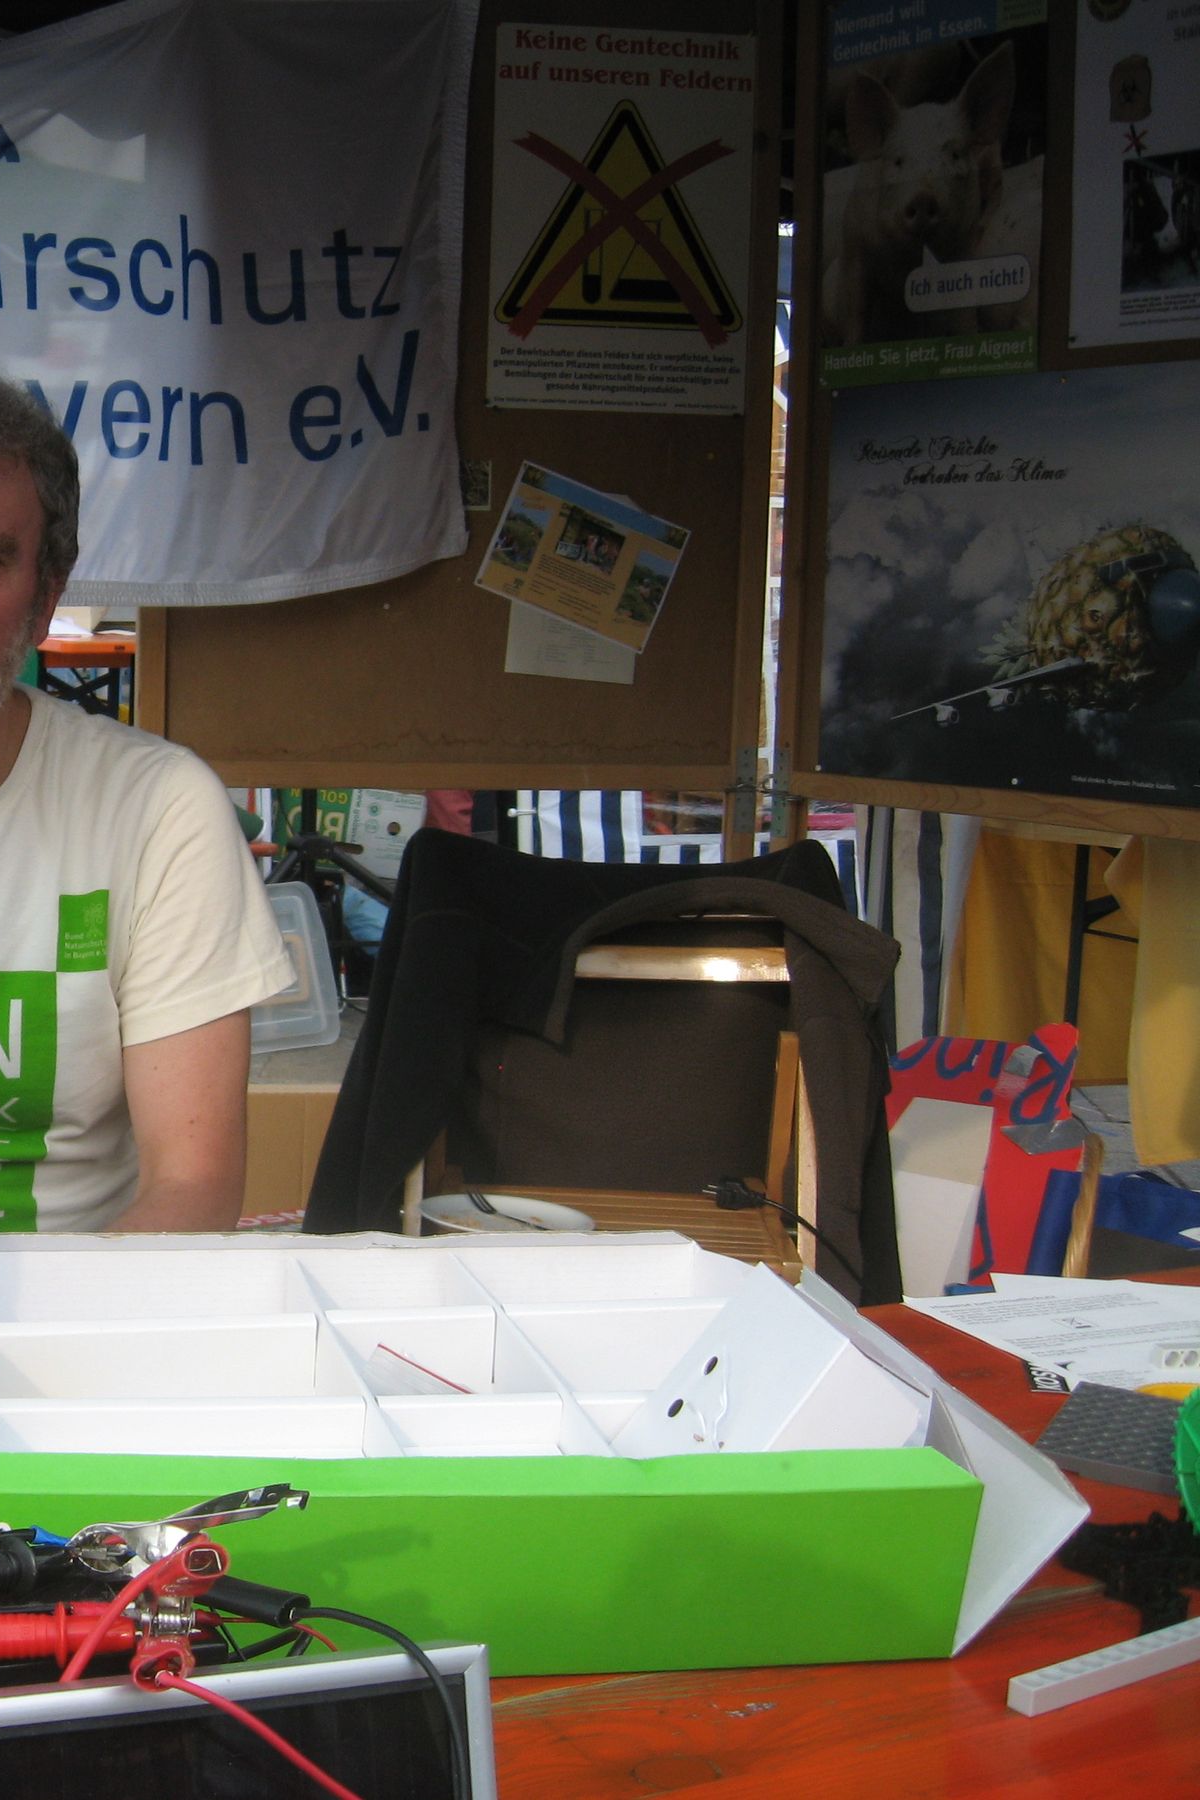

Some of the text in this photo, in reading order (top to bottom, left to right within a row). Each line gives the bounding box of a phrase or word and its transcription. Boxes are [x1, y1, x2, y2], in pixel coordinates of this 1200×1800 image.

[833, 6, 895, 35] Niemand
[515, 29, 740, 60] Keine Gentechnik
[833, 15, 987, 62] Gentechnik im Essen.
[498, 59, 753, 93] auf unseren Feldern
[911, 266, 1024, 296] Ich auch nicht!
[824, 351, 874, 372] Handeln
[879, 348, 901, 366] Sie
[904, 346, 939, 367] jetzt,
[944, 343, 975, 360] Frau
[289, 328, 430, 462] e.V.
[1009, 458, 1070, 482] Klima
